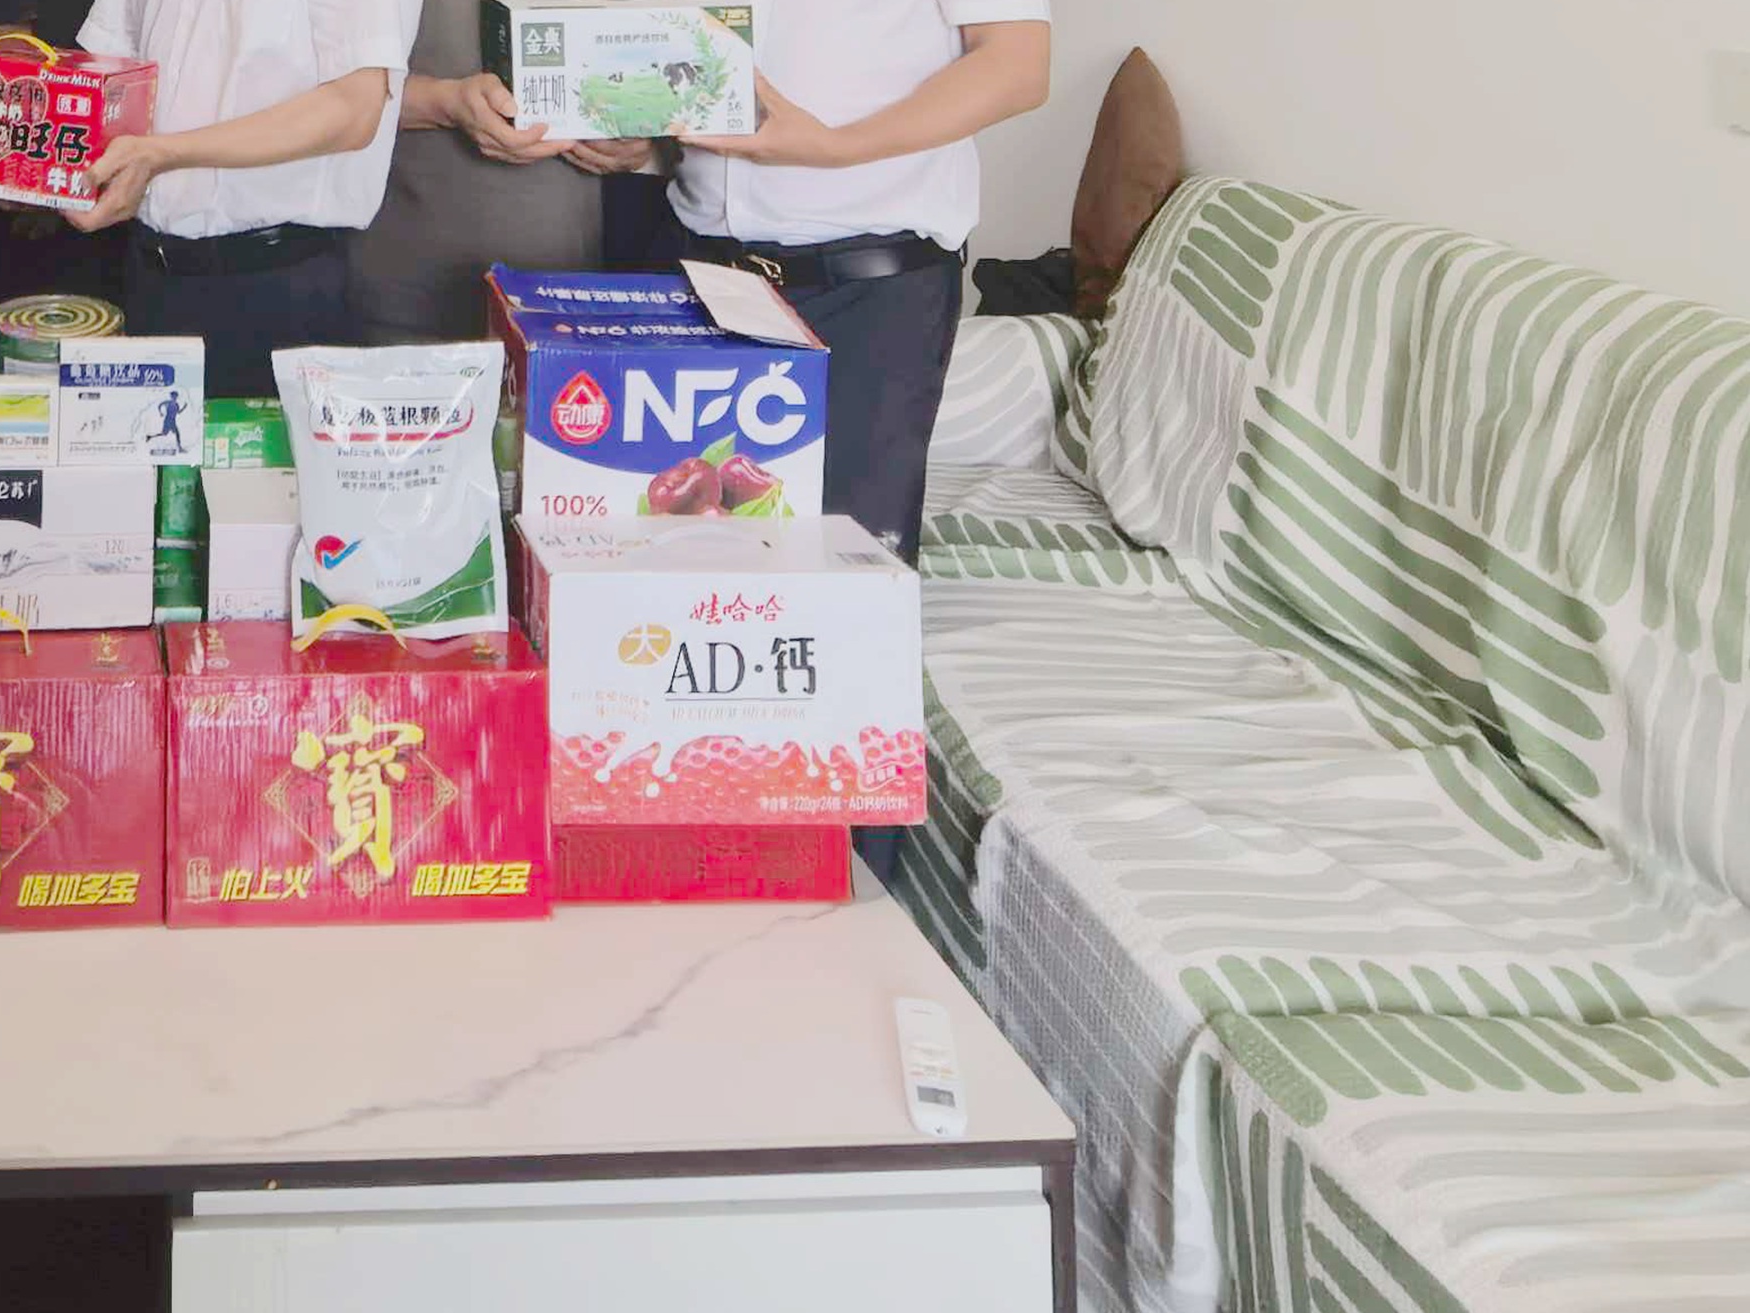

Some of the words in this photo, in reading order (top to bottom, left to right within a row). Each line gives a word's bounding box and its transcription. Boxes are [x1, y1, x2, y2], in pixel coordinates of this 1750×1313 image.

[524, 26, 562, 56] 金典
[72, 74, 101, 89] MILK
[521, 74, 567, 116] 纯牛奶
[10, 121, 91, 165] 旺仔
[622, 360, 807, 446] NFC
[541, 494, 607, 515] 100%
[690, 592, 786, 626] 娃哈哈
[17, 872, 142, 908] 喝加多宝
[219, 864, 314, 902] 怕上火
[411, 861, 532, 898] 喝加多宝
